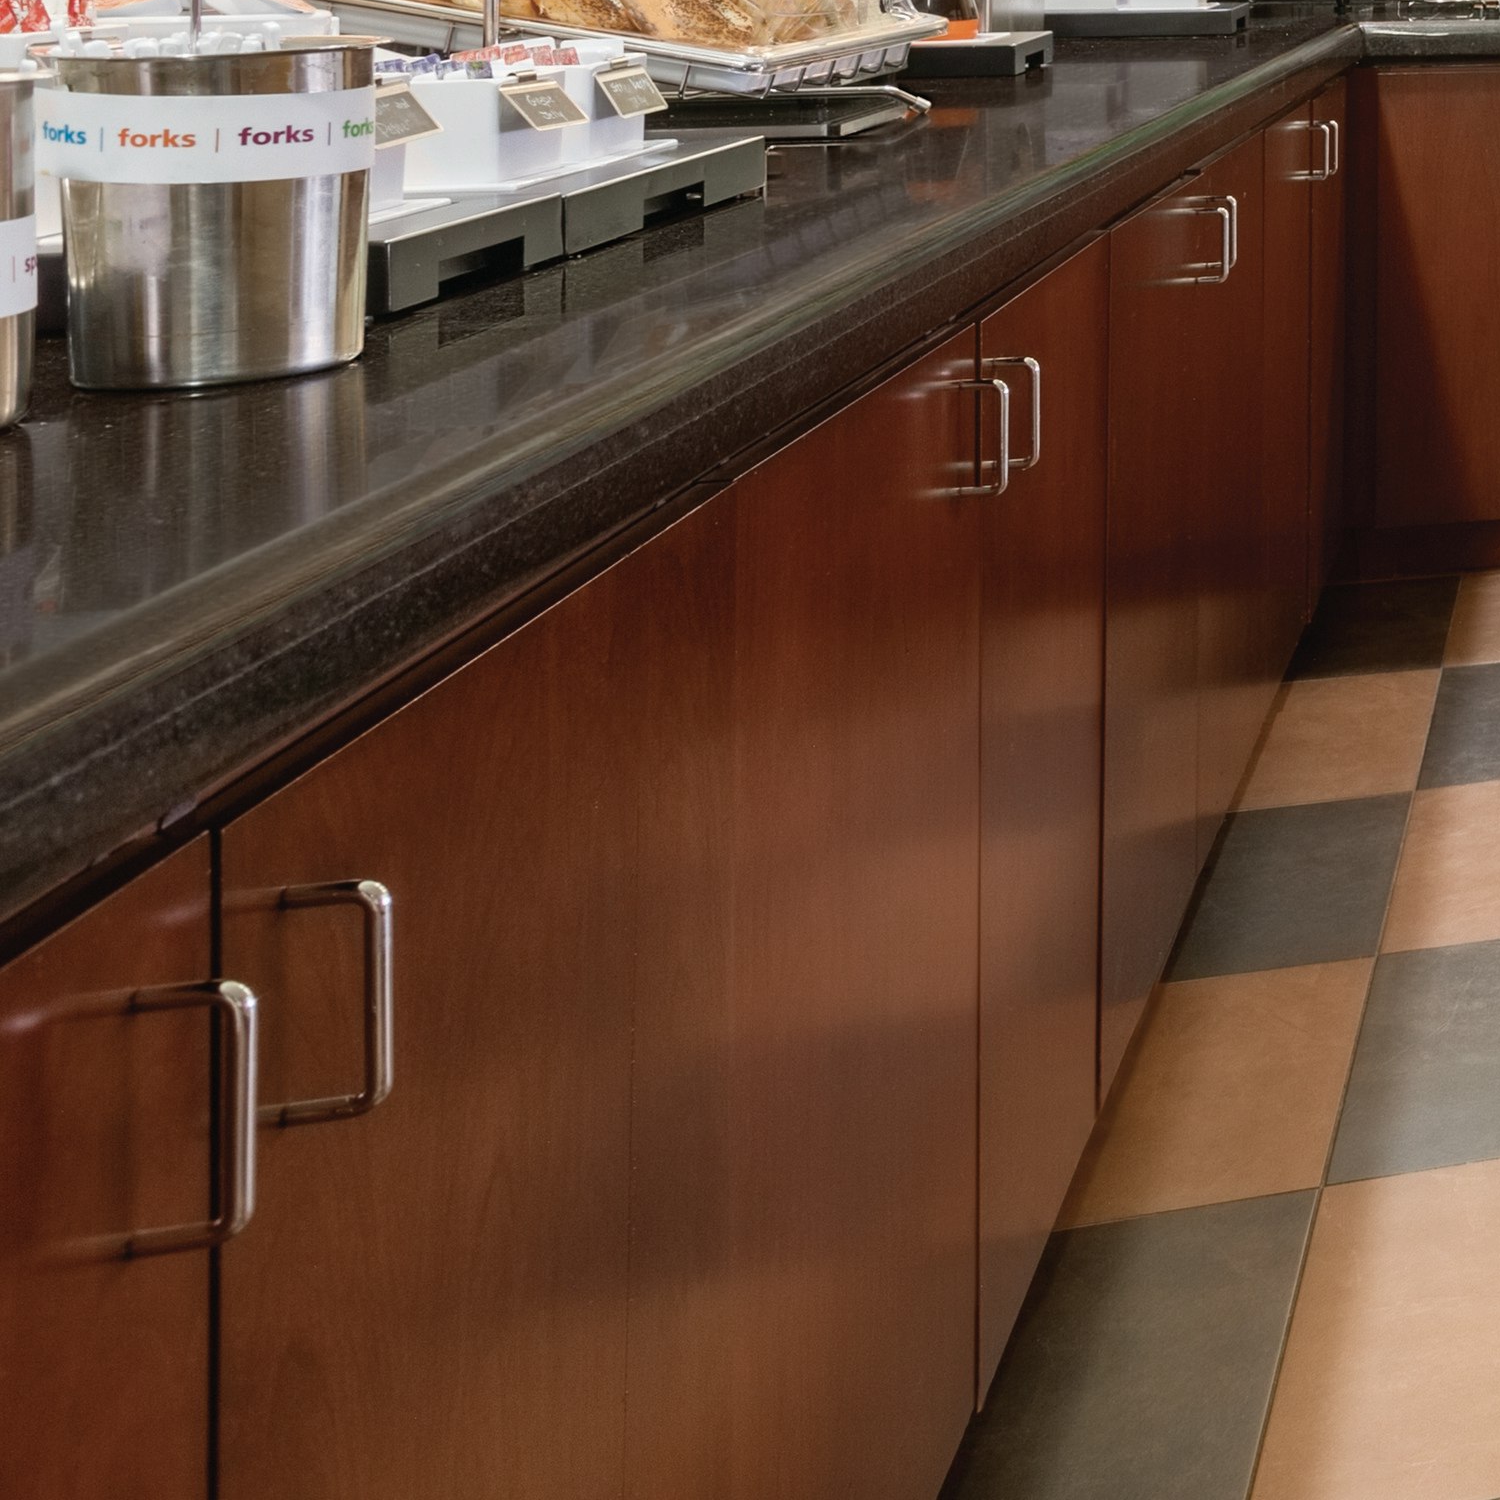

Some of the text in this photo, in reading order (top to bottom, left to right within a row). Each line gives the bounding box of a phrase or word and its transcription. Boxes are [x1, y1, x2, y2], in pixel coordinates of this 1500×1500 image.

[42, 121, 87, 145] forks
[118, 128, 197, 148] forks
[238, 125, 315, 146] forks
